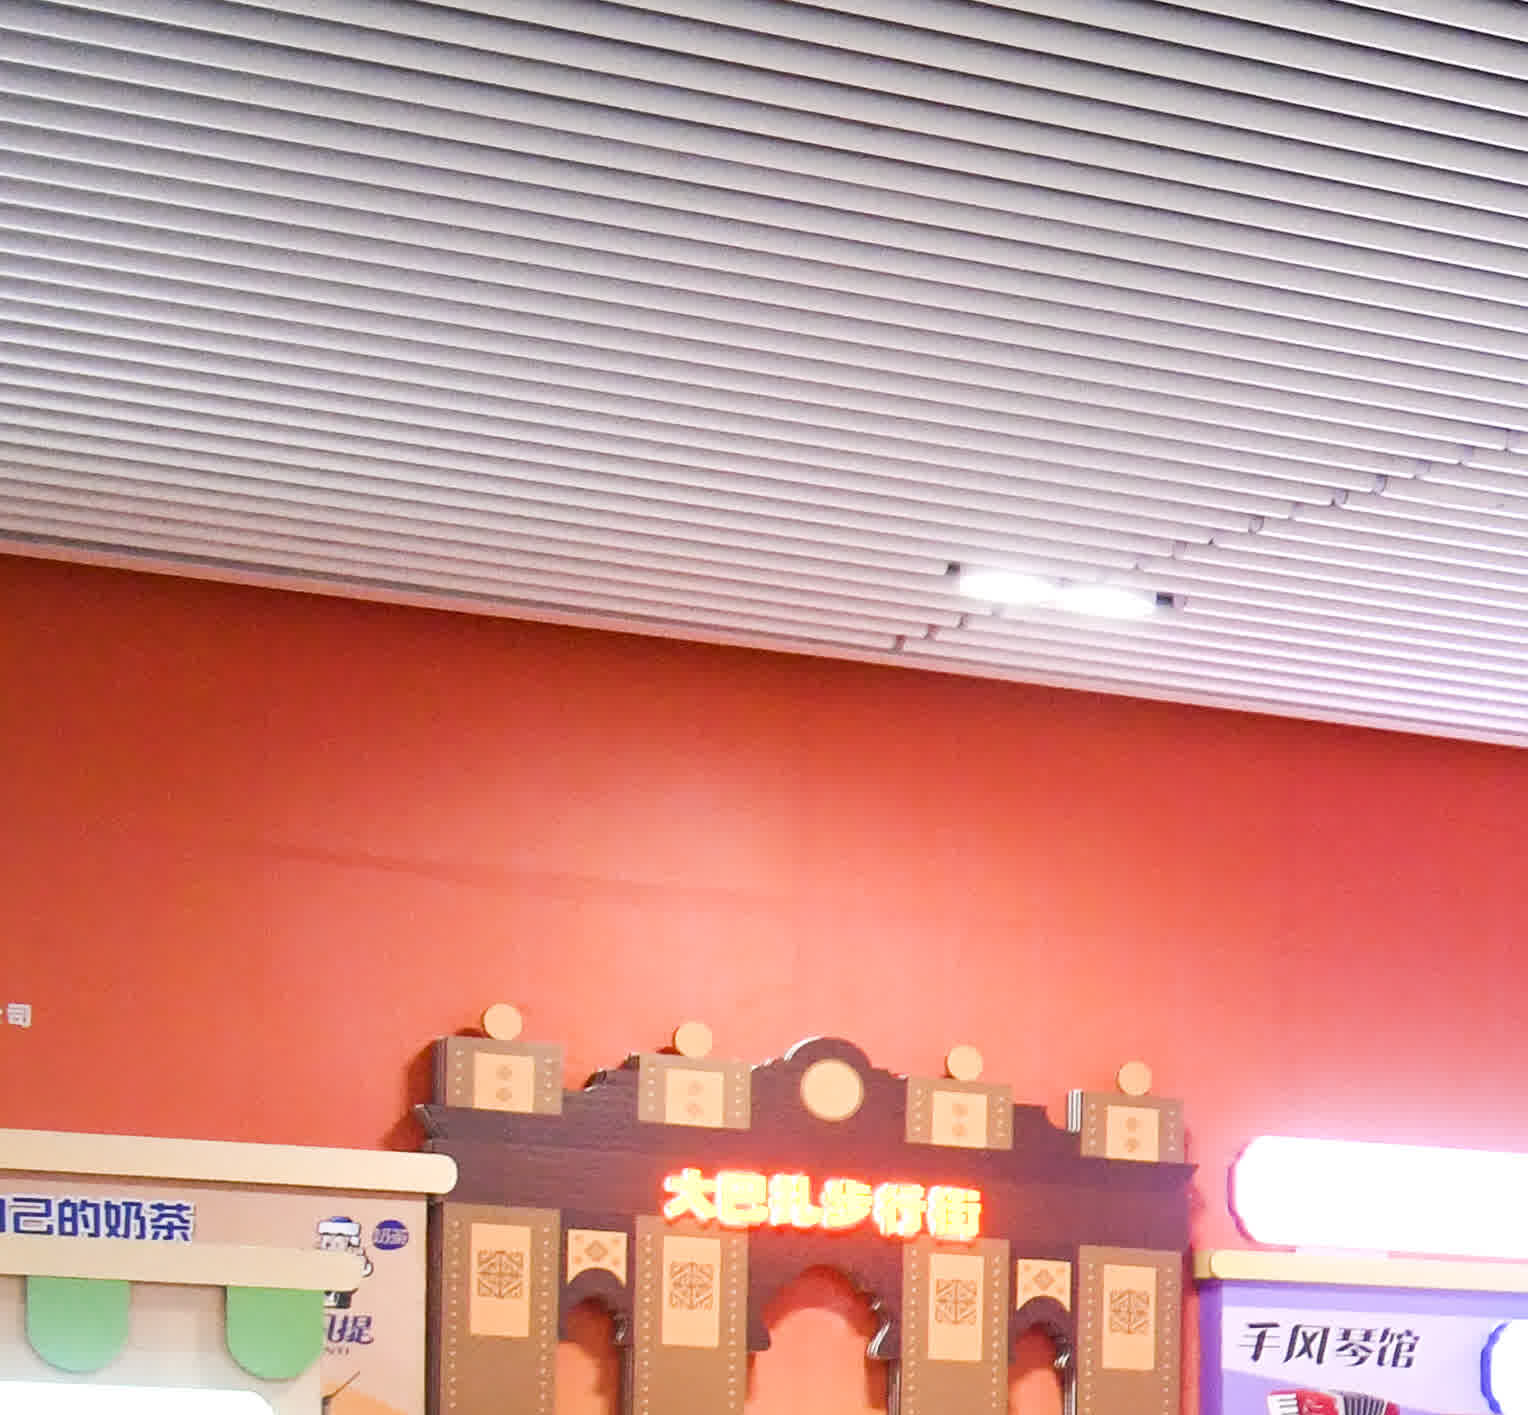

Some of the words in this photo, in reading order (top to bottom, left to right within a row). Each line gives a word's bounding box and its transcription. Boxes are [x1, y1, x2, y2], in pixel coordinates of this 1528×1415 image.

[0, 1196, 191, 1241] 己的奶茶
[1239, 1322, 1420, 1369] 手风琴馆
